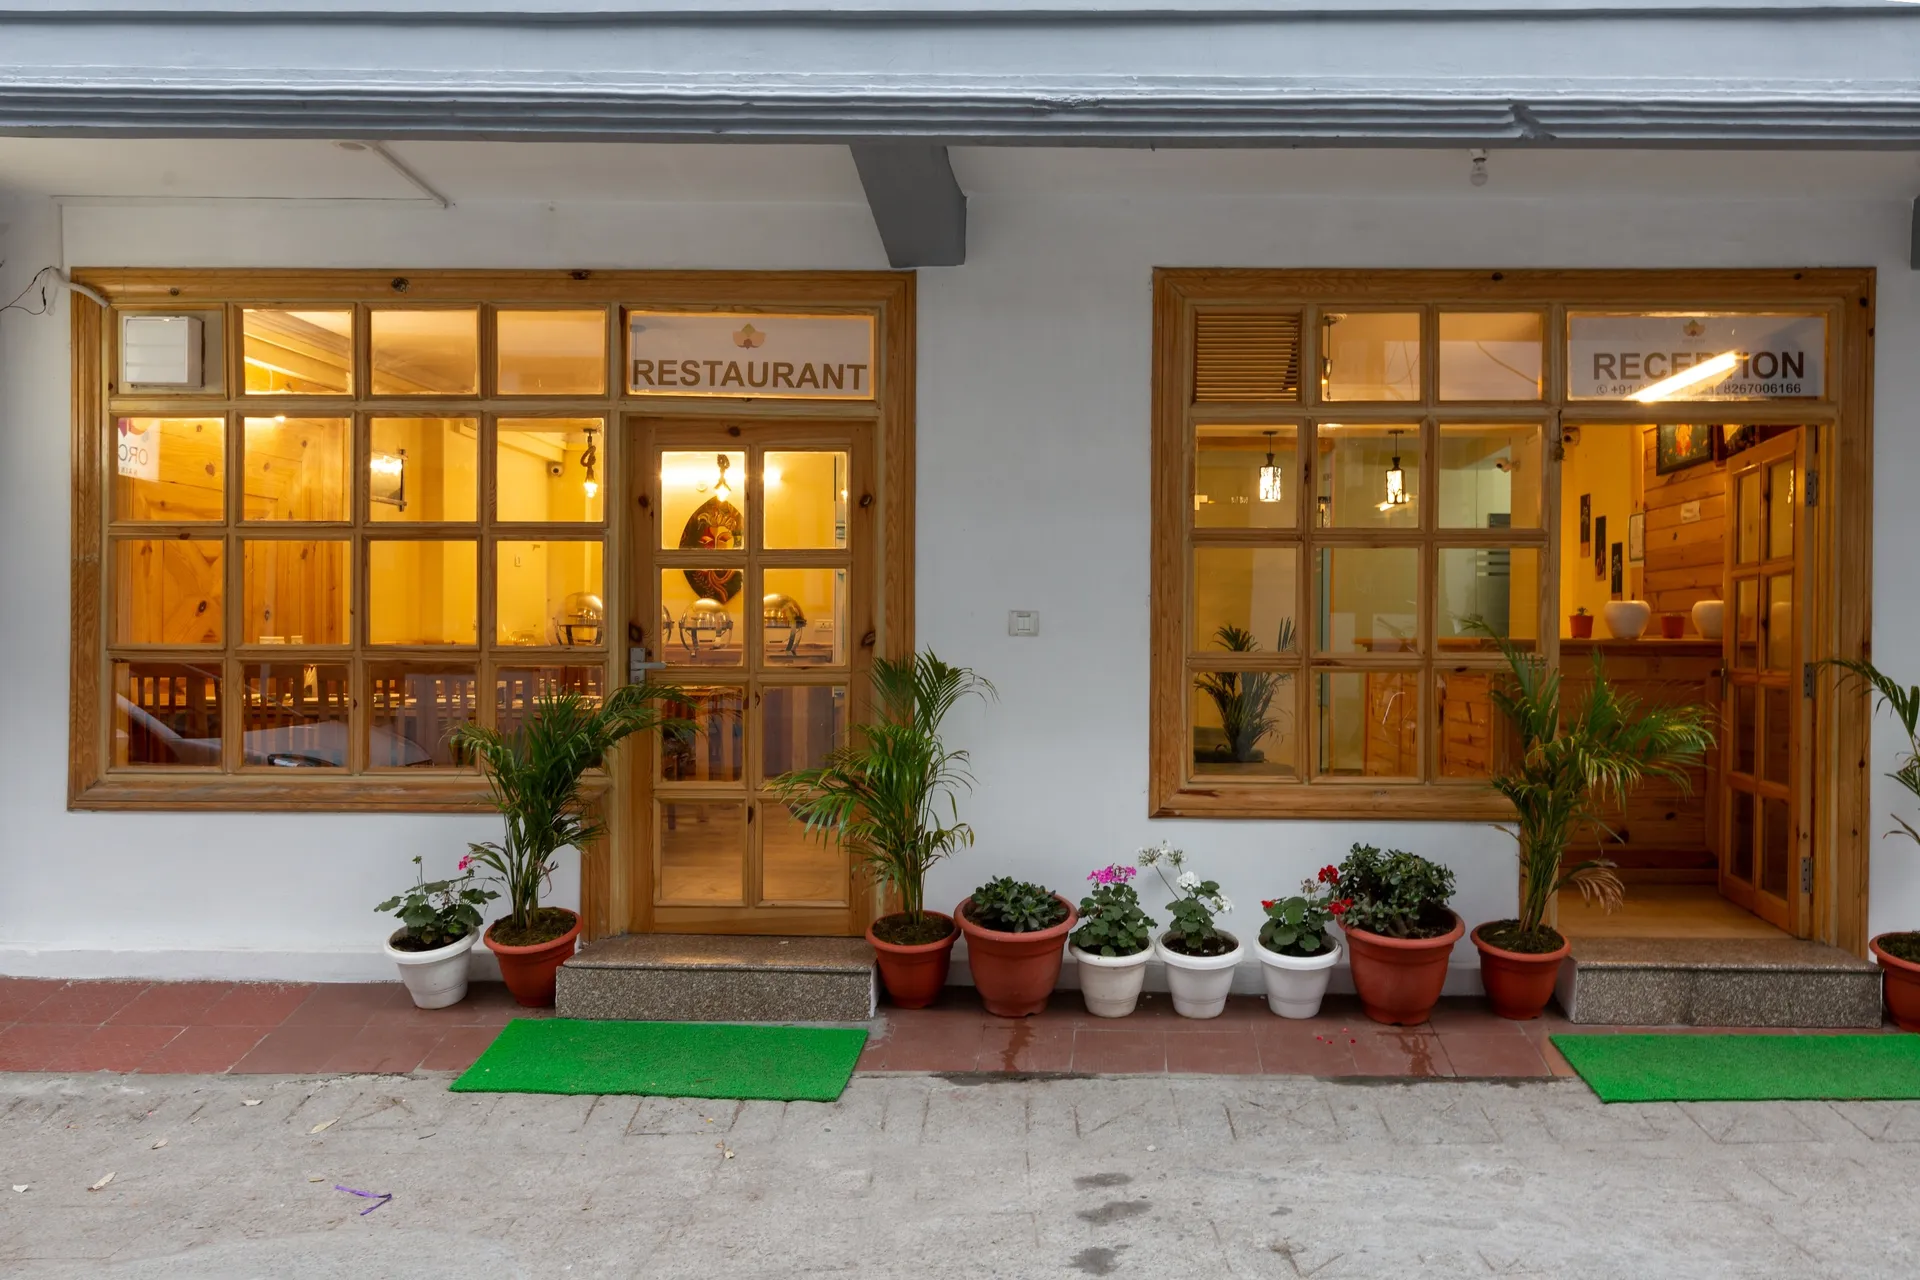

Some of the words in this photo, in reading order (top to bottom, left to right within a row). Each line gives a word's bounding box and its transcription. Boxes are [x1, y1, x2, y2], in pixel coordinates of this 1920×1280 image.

[633, 359, 868, 390] RESTAURANT
[1593, 351, 1804, 381] RECEION
[1723, 382, 1802, 395] 8267006166
